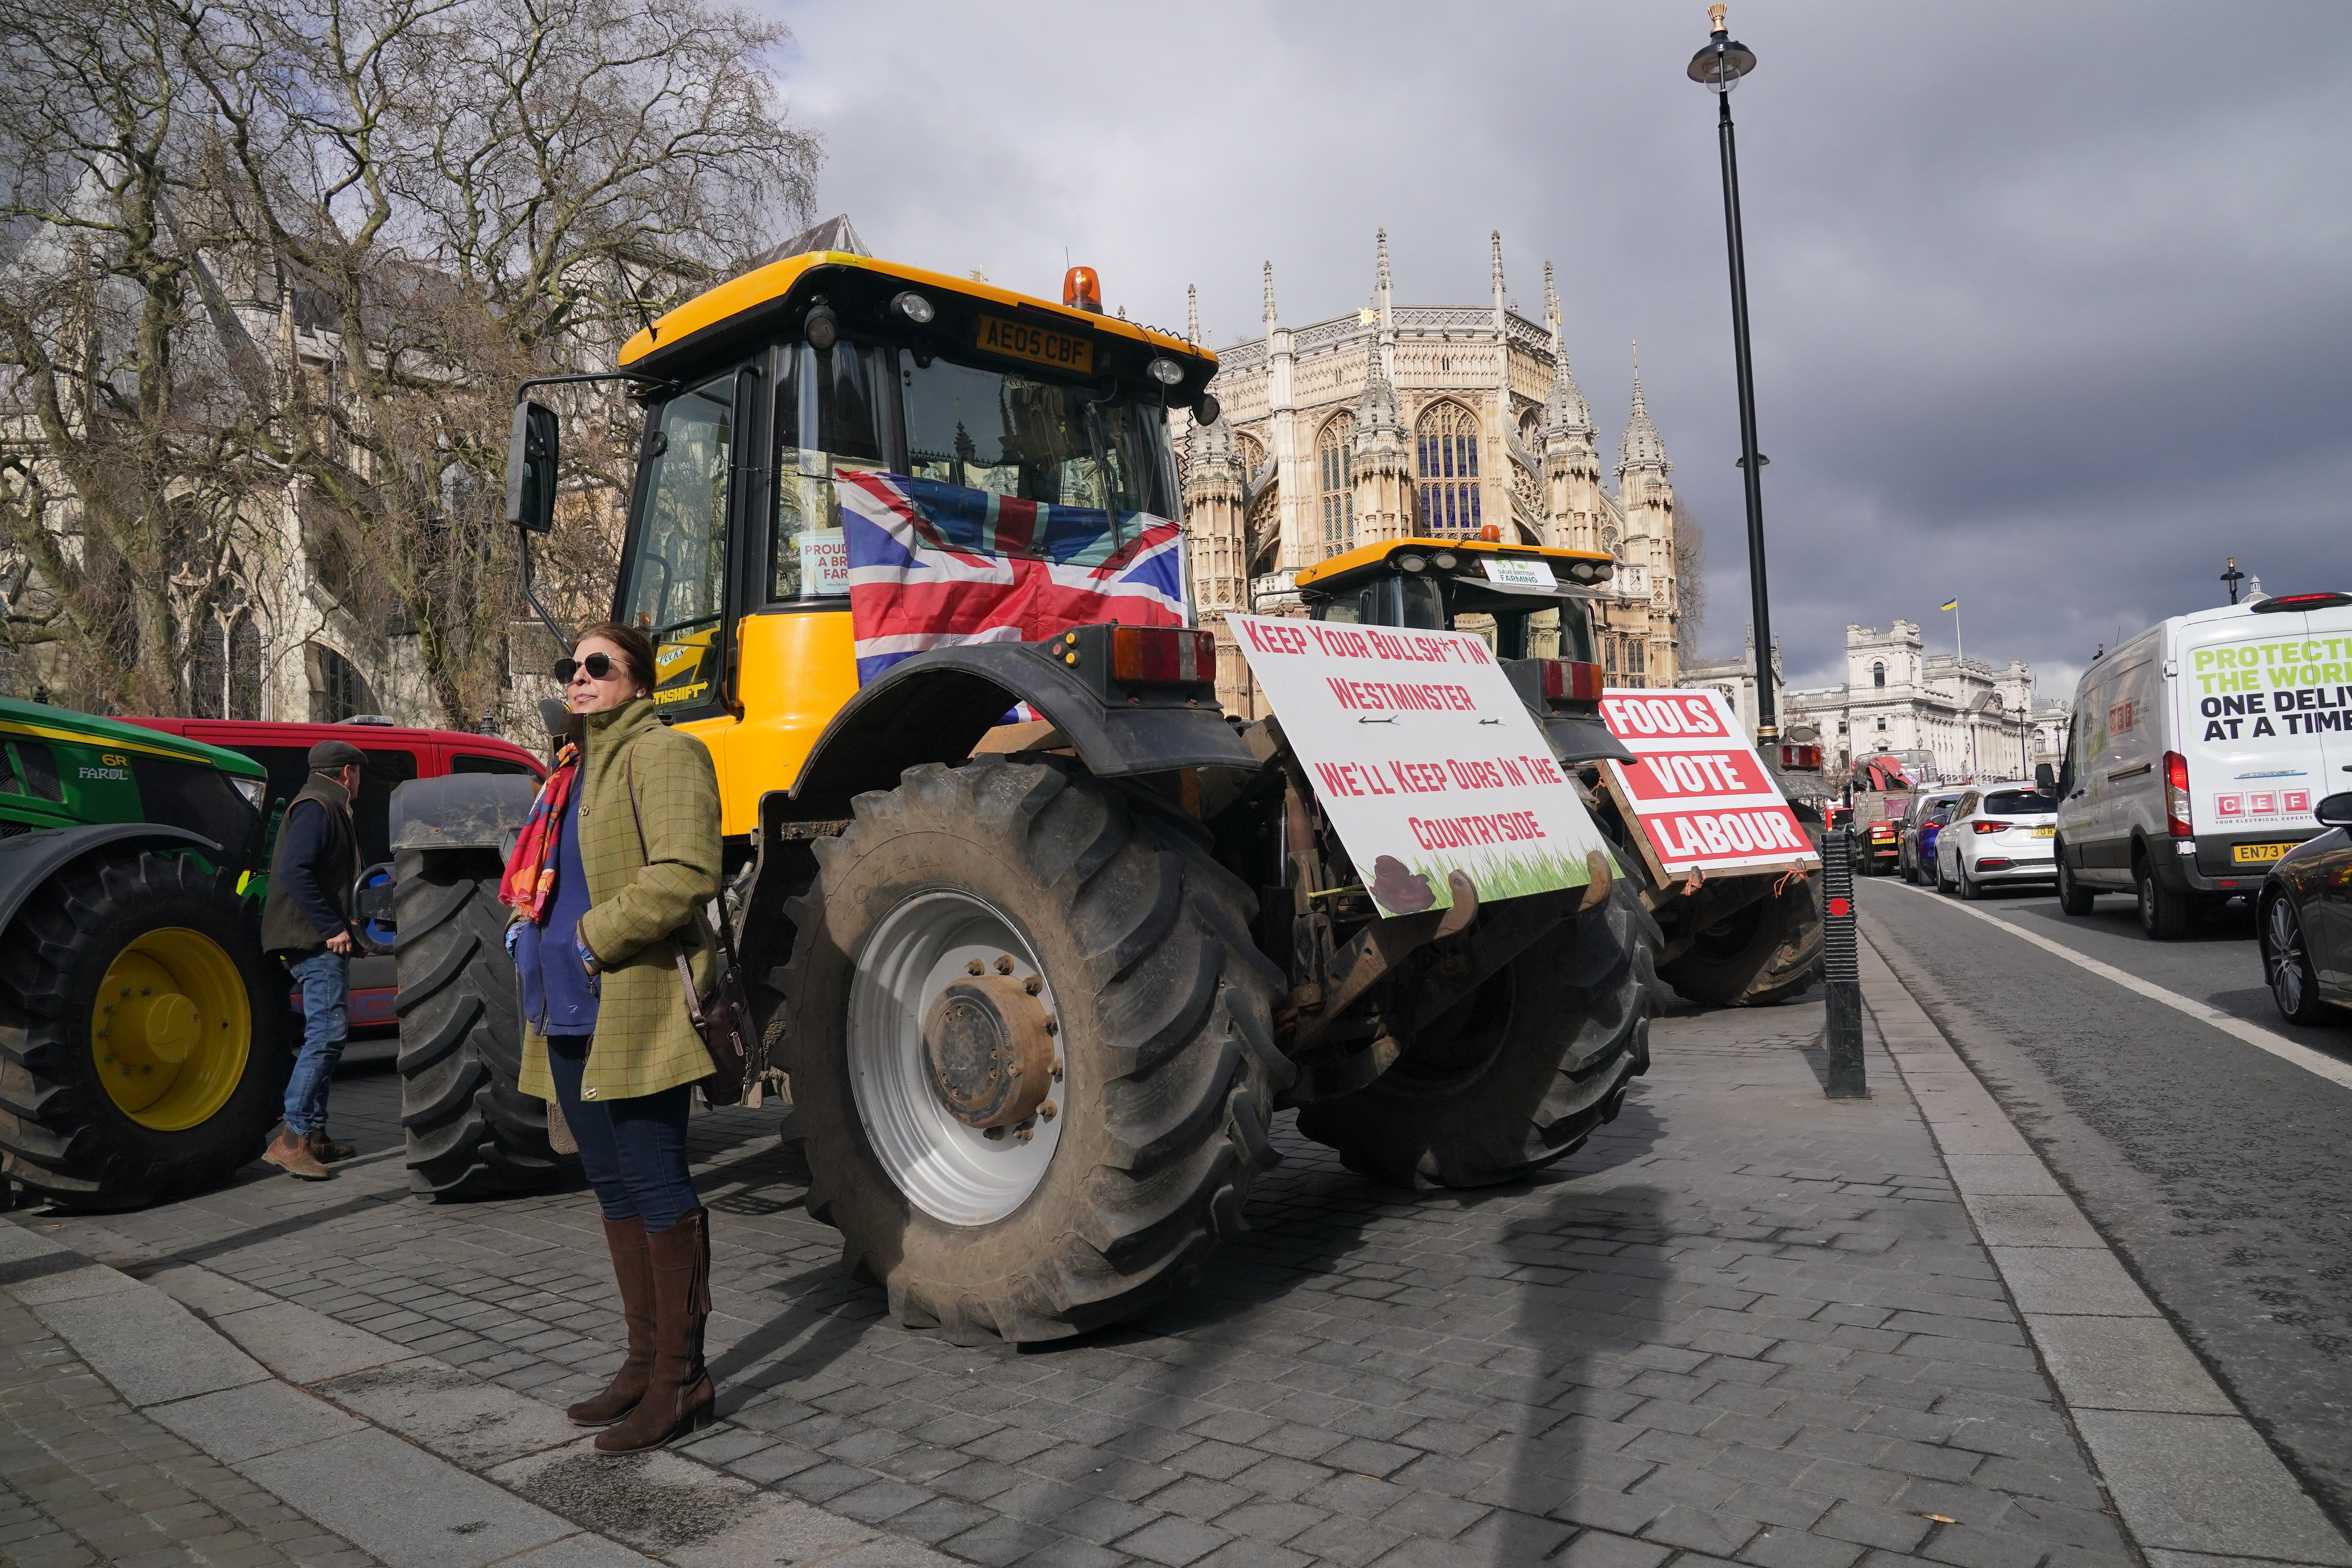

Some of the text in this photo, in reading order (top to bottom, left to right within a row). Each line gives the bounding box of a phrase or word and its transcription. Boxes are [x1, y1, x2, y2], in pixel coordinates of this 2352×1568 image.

[986, 320, 1084, 365] AE05 CBF
[818, 557, 828, 567] A
[824, 568, 849, 579] FAR
[1500, 575, 1538, 583] FARMING
[1241, 620, 1307, 655] KEEP
[1306, 625, 1373, 659] YOUR
[1462, 637, 1490, 664] IN
[653, 681, 707, 705] THSHIFT
[1326, 677, 1477, 710] WESTMINSTER
[2196, 669, 2261, 694] THE
[1602, 699, 1719, 734] FOOLS
[2201, 693, 2266, 718] ONE
[2203, 718, 2243, 742] AT
[2252, 716, 2276, 738] A
[102, 754, 128, 767] 6R
[78, 767, 128, 780] FAROL
[1314, 756, 1563, 797] WE'LL KEEP OURS IN THE
[1642, 755, 1747, 793] VOTE
[2223, 795, 2300, 811] CEF
[1408, 811, 1546, 851] COUNTRYSIDE
[1650, 811, 1803, 857] LABOUR
[2240, 846, 2279, 859] EN73
